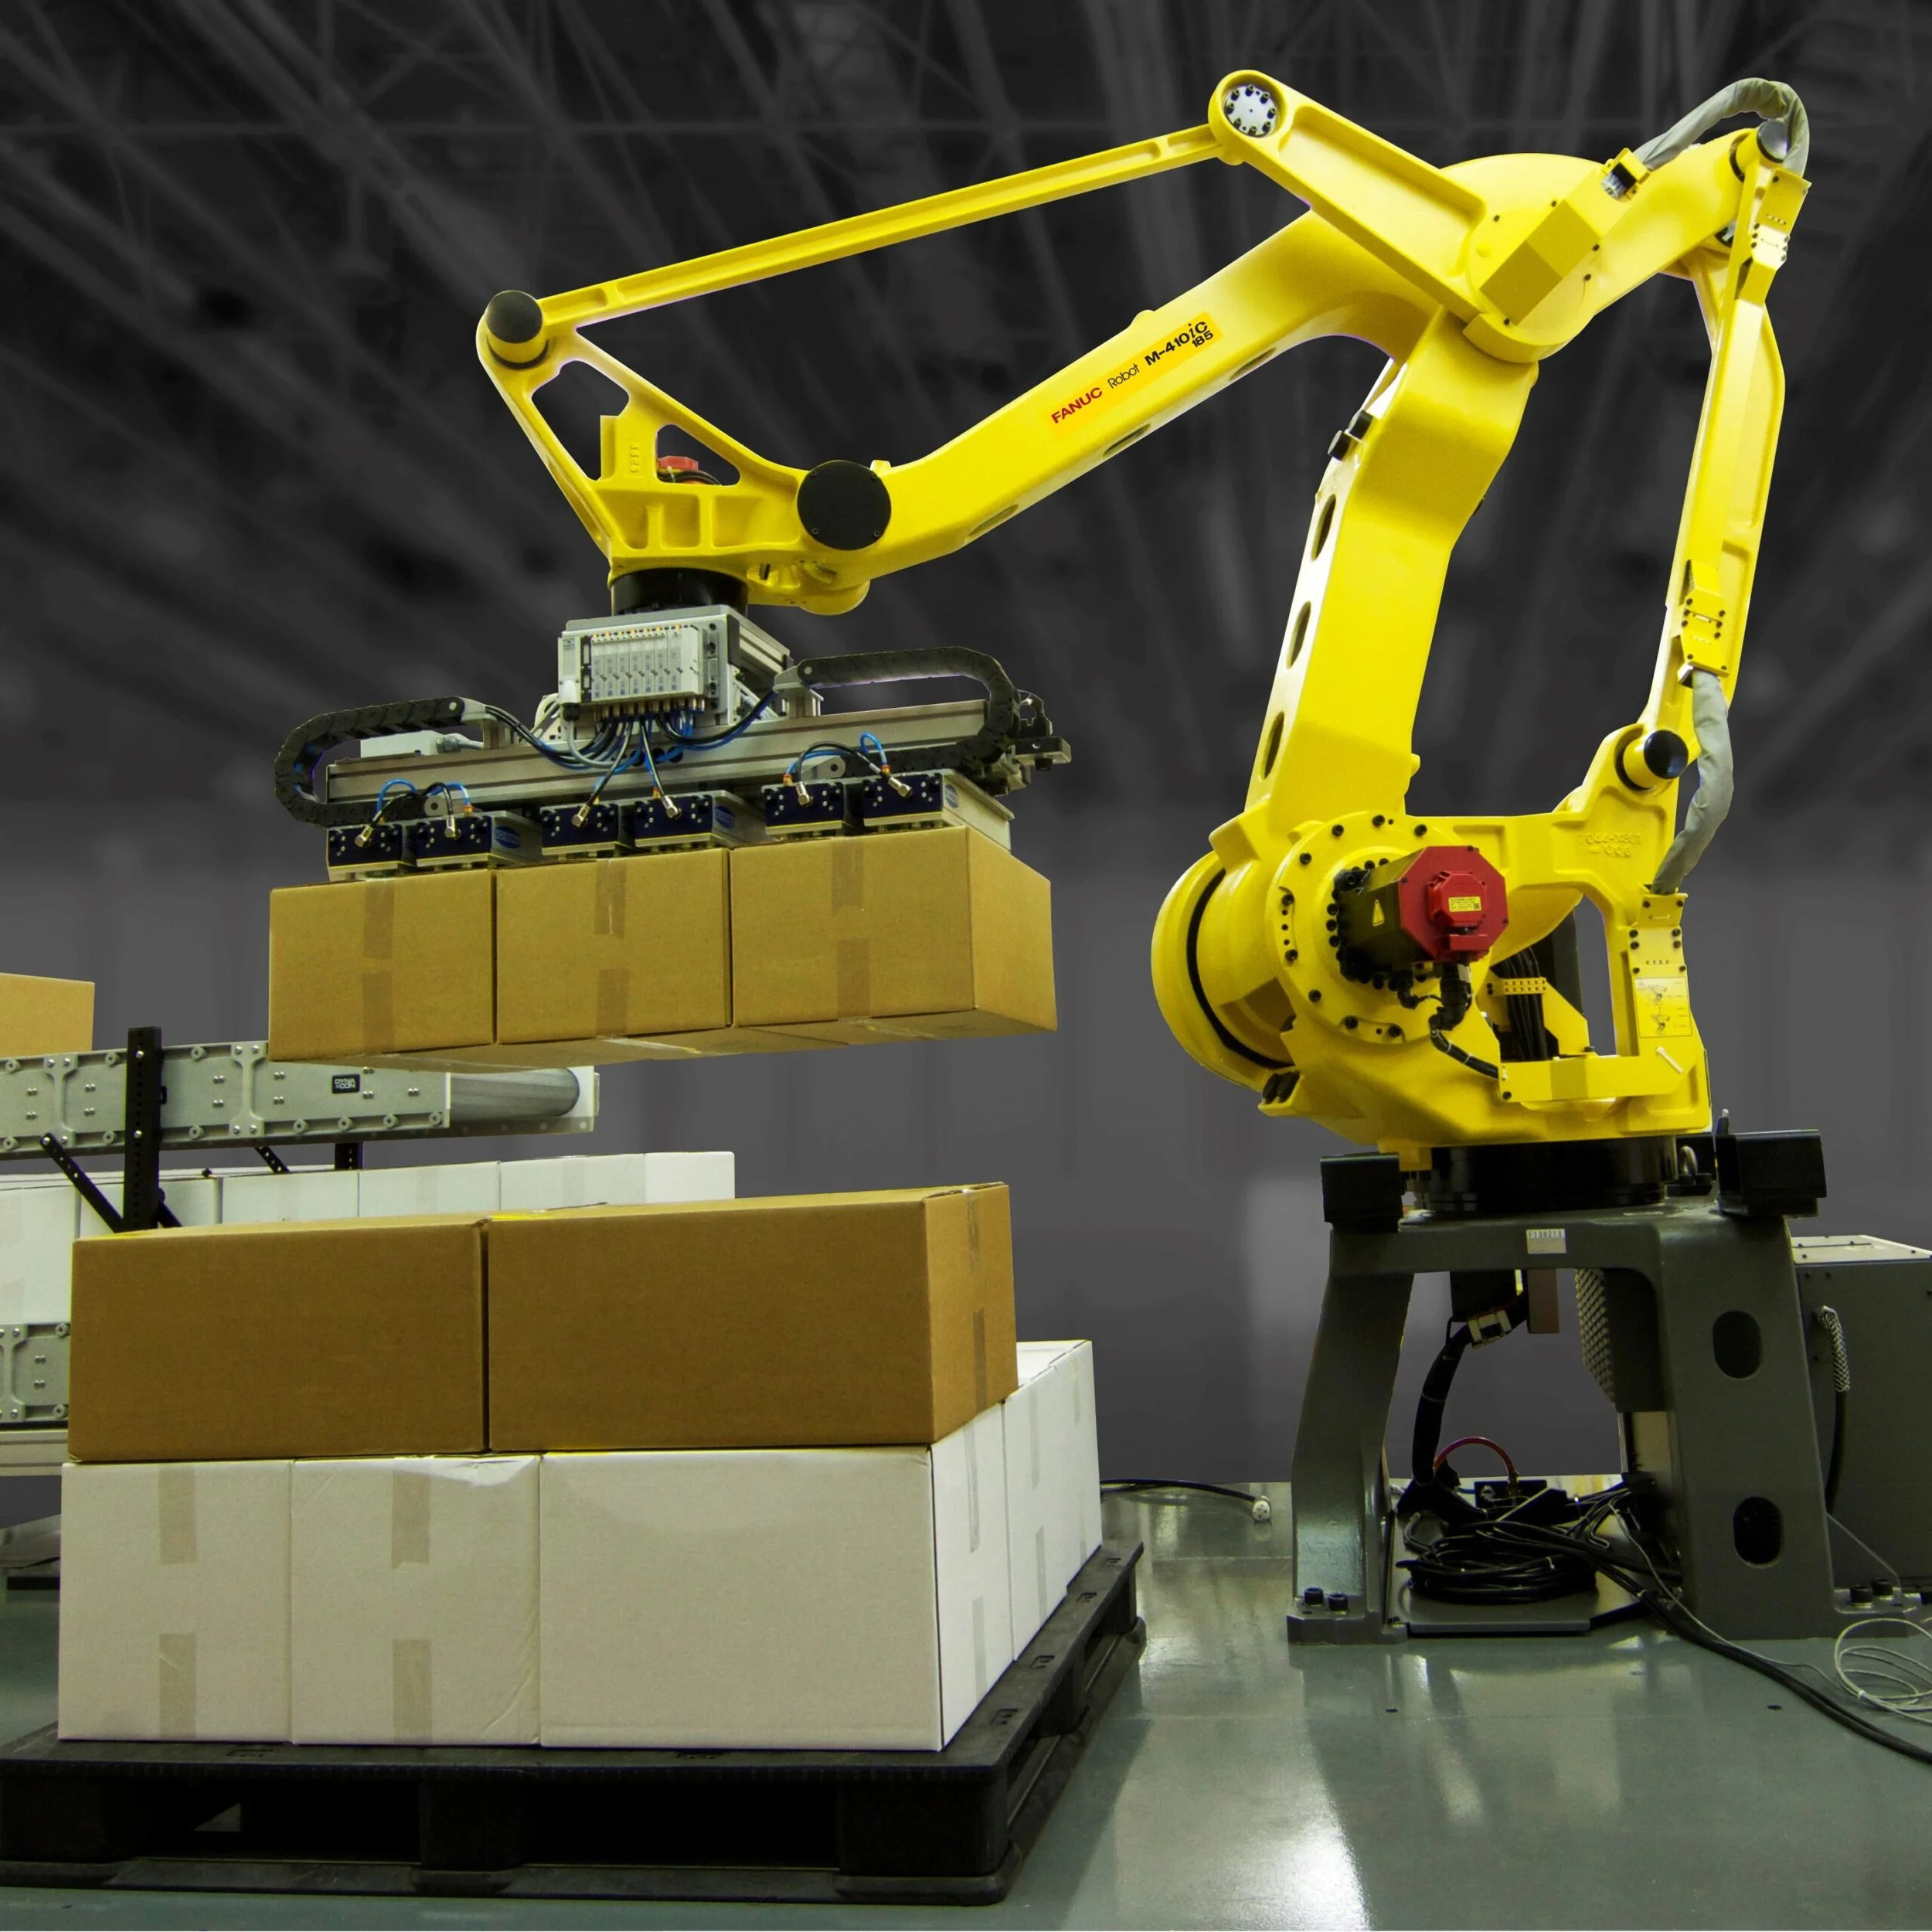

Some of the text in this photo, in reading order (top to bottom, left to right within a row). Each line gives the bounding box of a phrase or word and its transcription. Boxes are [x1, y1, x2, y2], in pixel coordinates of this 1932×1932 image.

[1192, 330, 1213, 347] 185
[1051, 321, 1208, 423] FANUC Robot M-410iC
